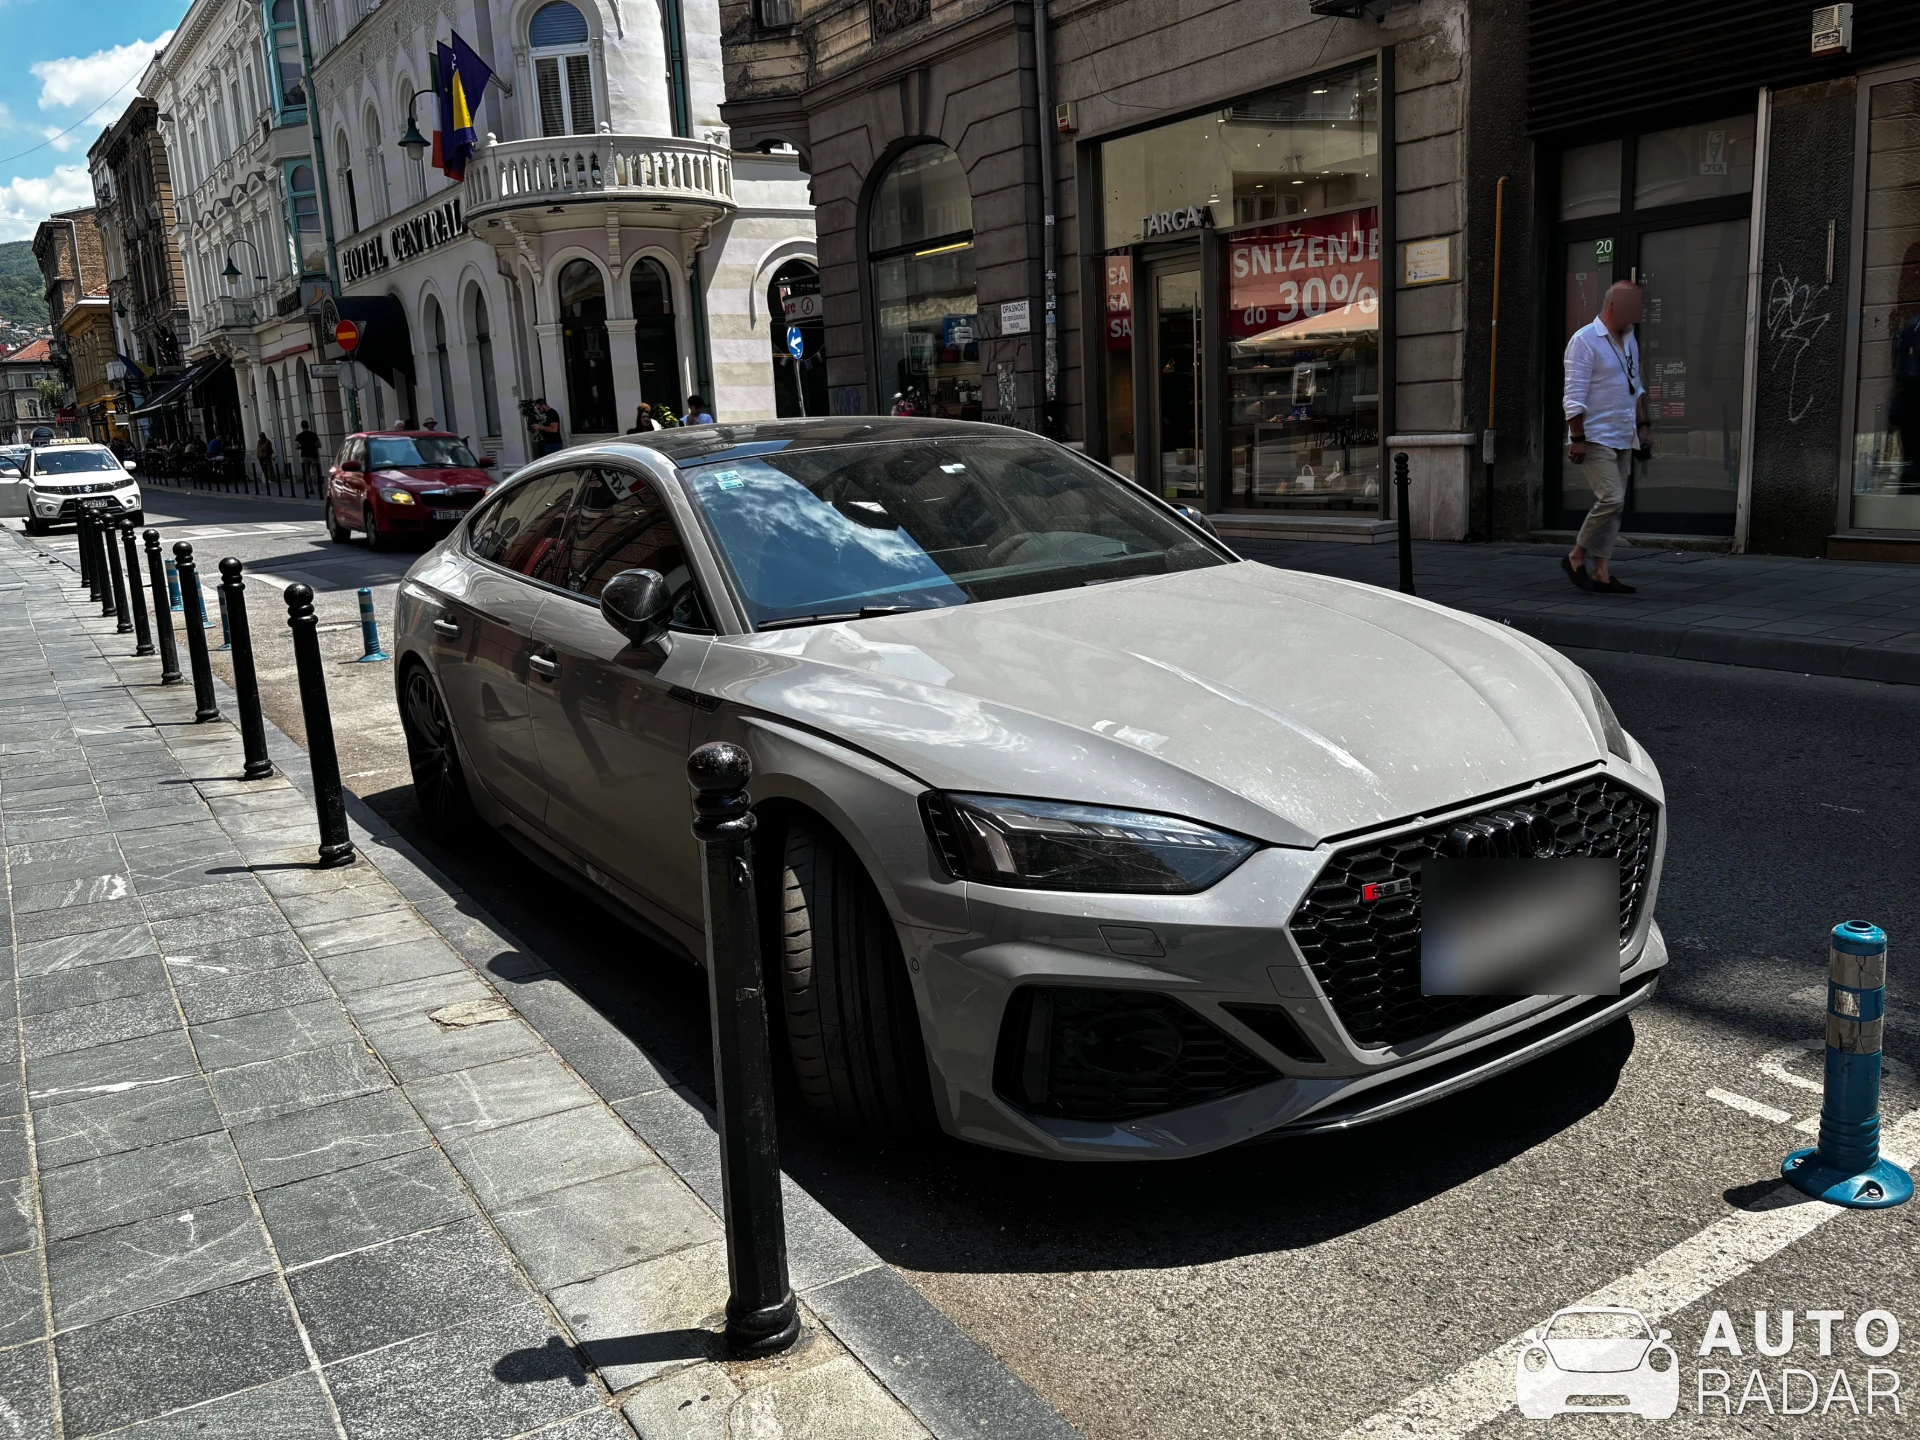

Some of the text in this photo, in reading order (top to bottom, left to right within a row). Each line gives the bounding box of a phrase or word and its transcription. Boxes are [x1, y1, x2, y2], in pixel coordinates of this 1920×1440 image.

[341, 200, 465, 282] HOTEL CENTRAL
[1138, 205, 1202, 238] TARGA
[1596, 239, 1612, 254] 20
[1233, 227, 1379, 278] SNIŽENJE
[1244, 272, 1378, 326] do 30%
